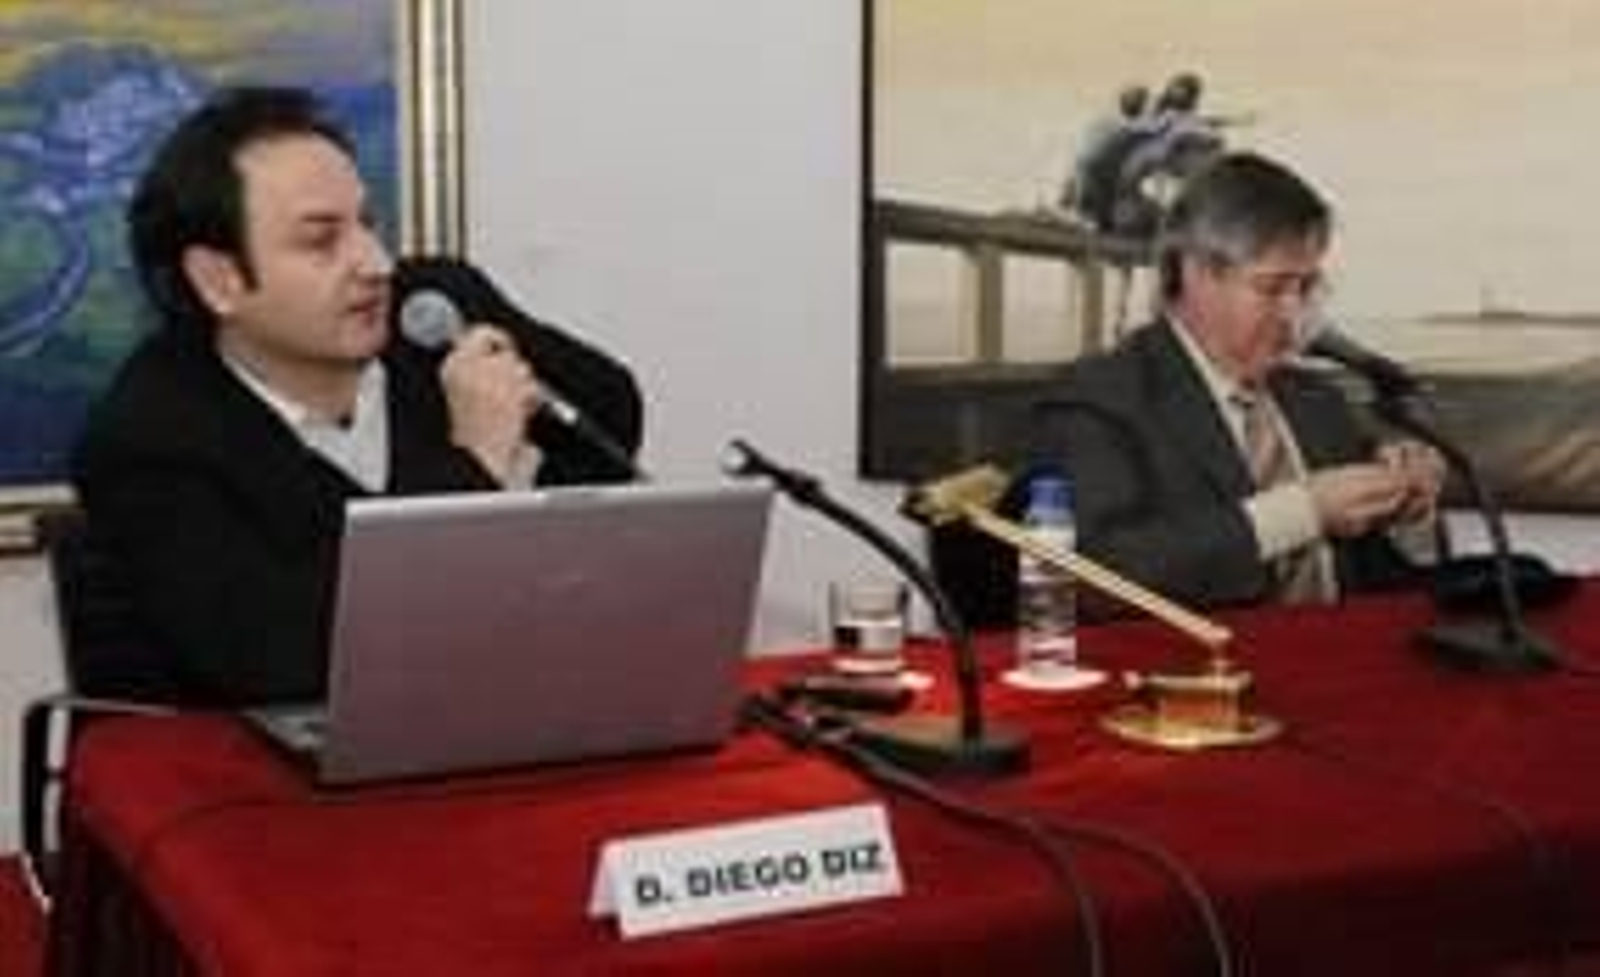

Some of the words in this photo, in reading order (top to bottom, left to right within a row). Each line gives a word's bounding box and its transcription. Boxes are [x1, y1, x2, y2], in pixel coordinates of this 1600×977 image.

[635, 875, 673, 905] D.
[687, 854, 810, 897] DIEGO
[821, 841, 883, 876] DIZ
